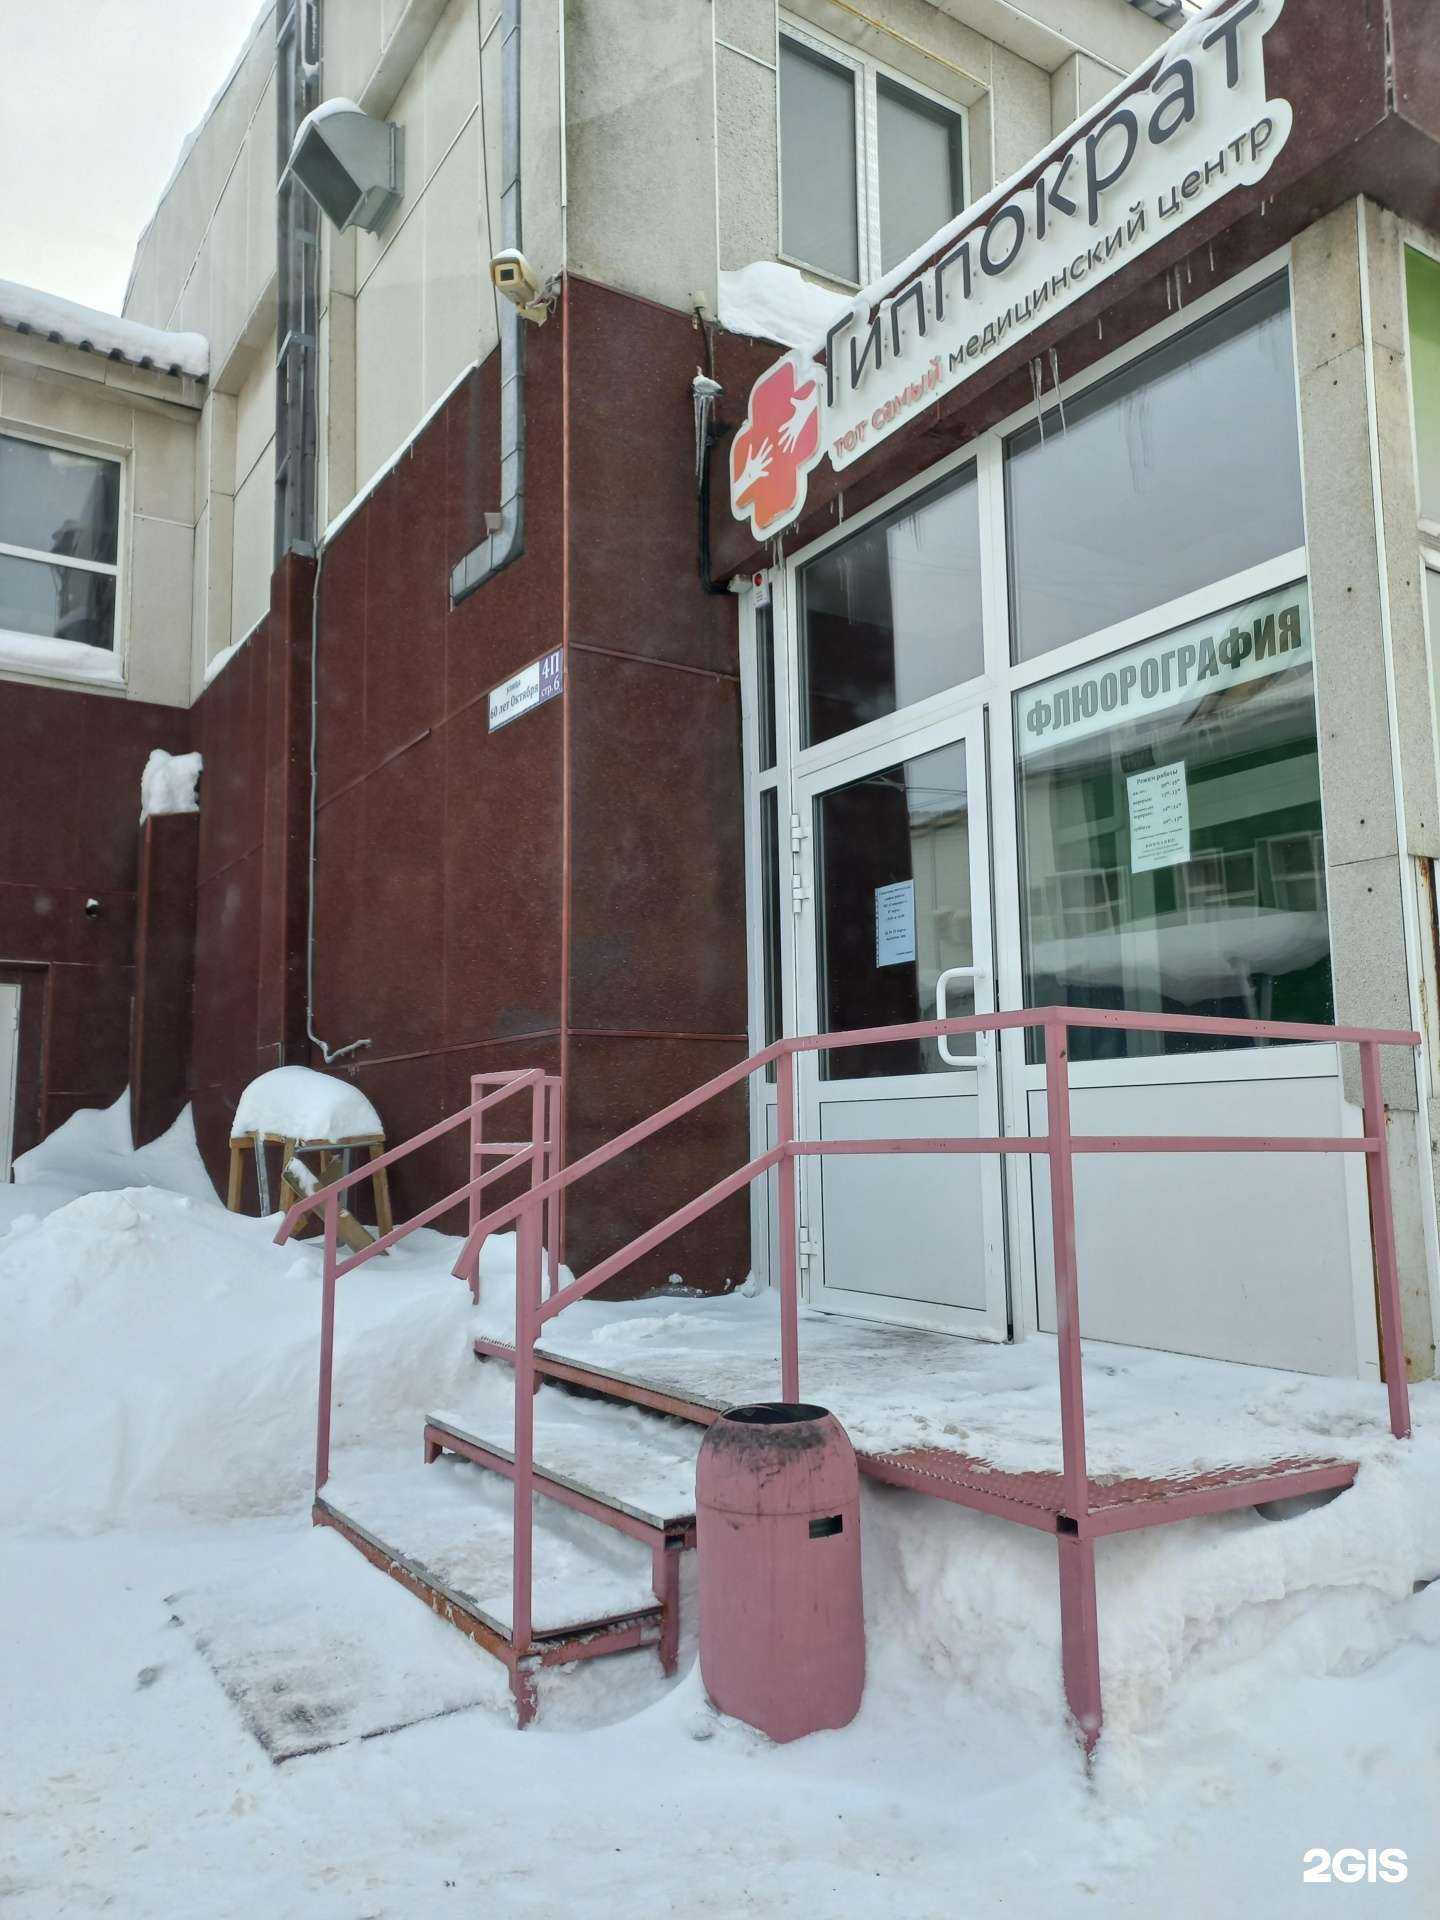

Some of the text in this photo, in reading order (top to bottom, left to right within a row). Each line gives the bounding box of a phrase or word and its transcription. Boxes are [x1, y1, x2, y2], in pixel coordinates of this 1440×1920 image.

[825, 0, 1260, 407] Гиппократ
[833, 117, 1274, 457] тот самый медицинский центр
[510, 683, 538, 707] Октября
[1026, 604, 1302, 736] ФЛЮОРОГРАФИЯ
